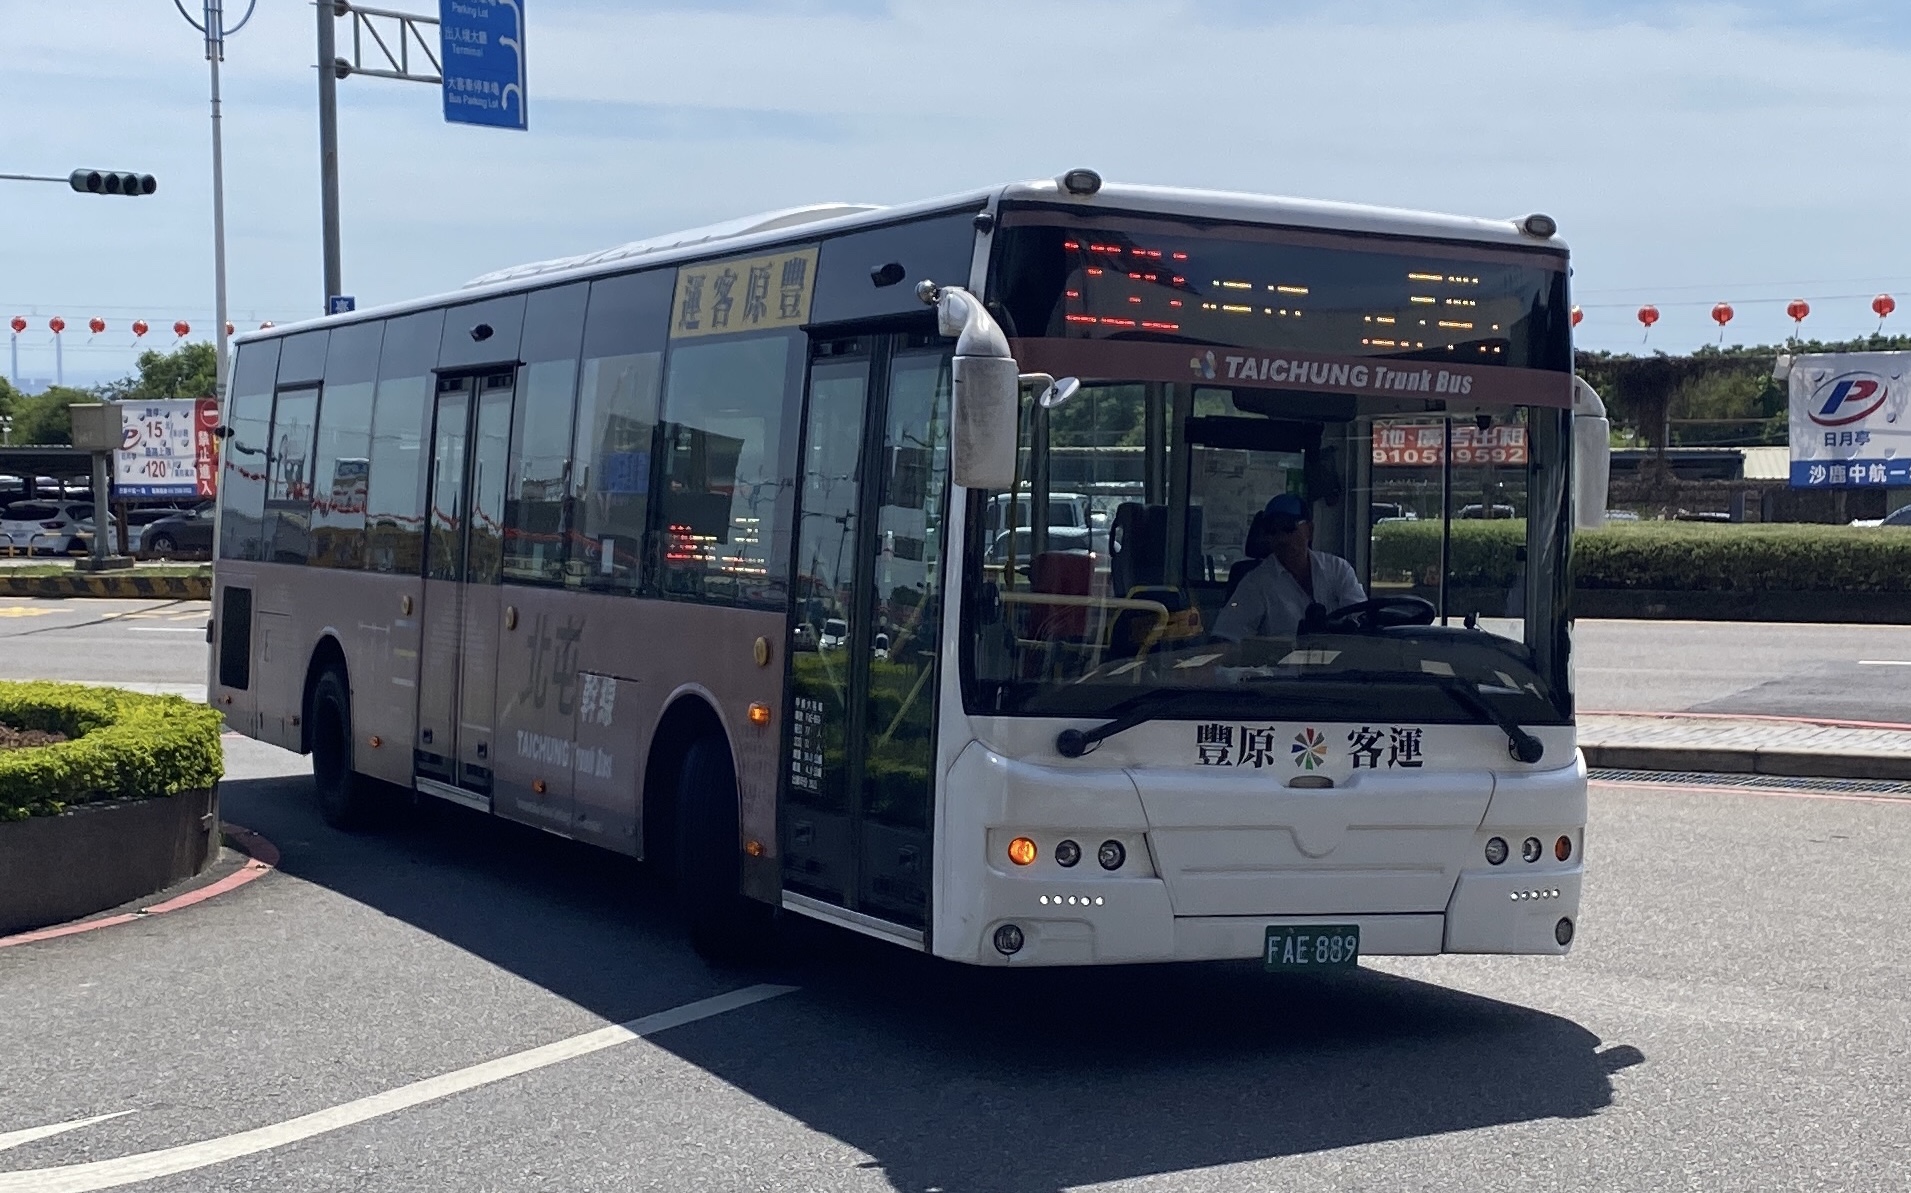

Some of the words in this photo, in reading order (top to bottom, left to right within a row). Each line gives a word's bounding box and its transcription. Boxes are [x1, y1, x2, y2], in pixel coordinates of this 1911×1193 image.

[452, 2, 477, 18] Parking
[478, 7, 489, 18] Lot
[451, 43, 484, 57] Terminal
[449, 92, 462, 103] Bus
[463, 95, 487, 109] Parking
[488, 97, 499, 109] Lot
[1225, 356, 1369, 387] TAICHUNG
[1374, 366, 1433, 392] Trunk
[1435, 370, 1473, 395] Bus
[146, 421, 163, 438] 15
[1824, 430, 1871, 447] 日月亭
[146, 460, 166, 478] 120
[1809, 463, 1911, 484] 沙鹿中航一
[517, 730, 569, 767] TAICHUNG
[1194, 723, 1276, 768] 豐原
[1347, 726, 1424, 770] 客運
